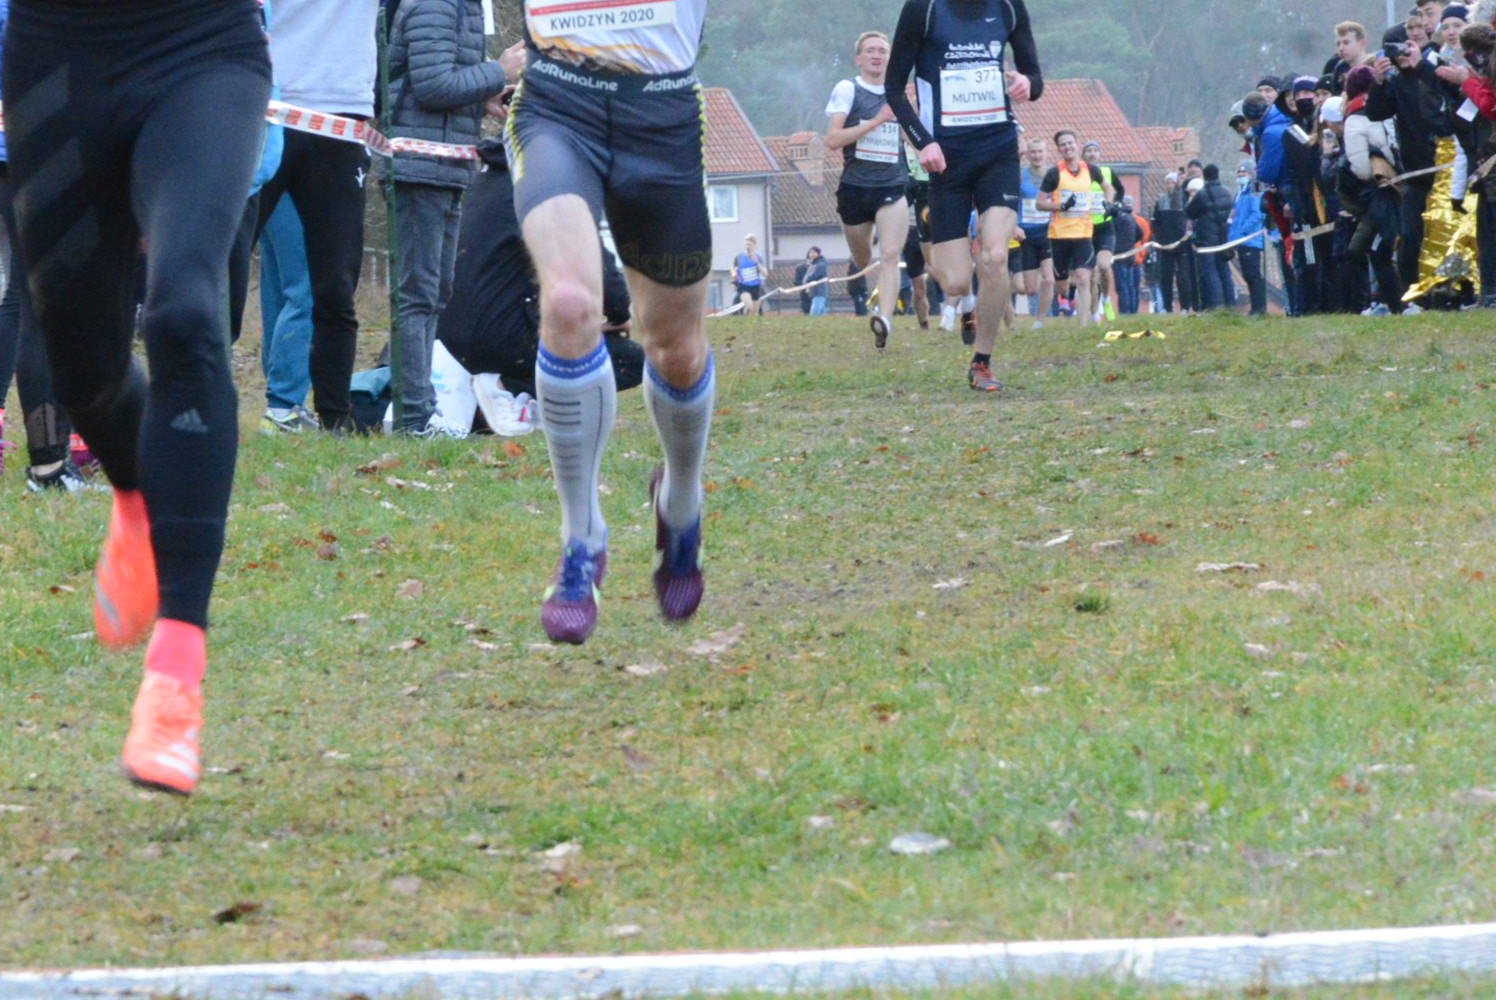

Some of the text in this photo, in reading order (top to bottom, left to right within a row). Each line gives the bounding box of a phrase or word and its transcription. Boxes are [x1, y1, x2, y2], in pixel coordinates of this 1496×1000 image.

[550, 7, 654, 31] KWIDZYN 2020
[952, 90, 996, 104] MUTWIL
